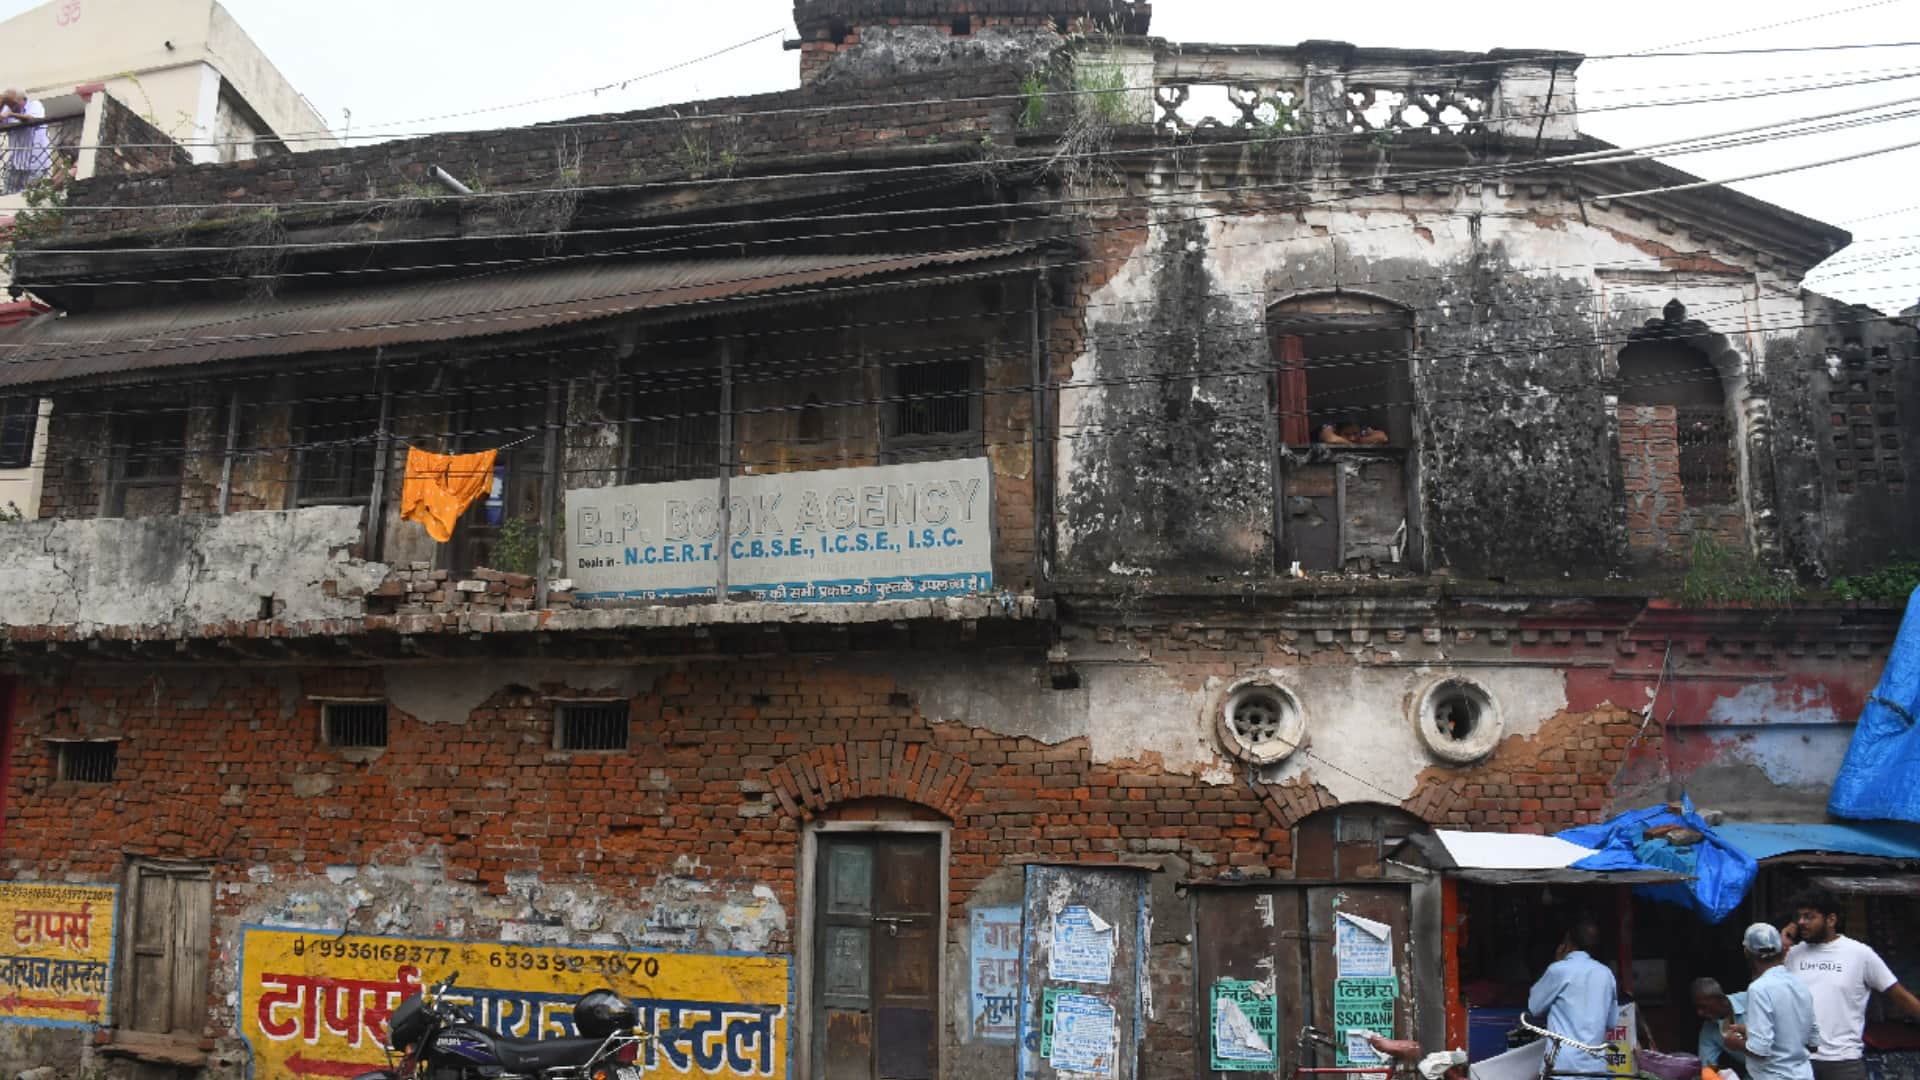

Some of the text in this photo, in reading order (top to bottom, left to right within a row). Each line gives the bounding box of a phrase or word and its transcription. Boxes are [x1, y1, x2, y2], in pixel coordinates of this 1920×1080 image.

[664, 494, 784, 542] BOOK
[795, 478, 981, 533] AGENCY
[578, 558, 604, 569] Deals
[907, 527, 964, 549] I.S.C.
